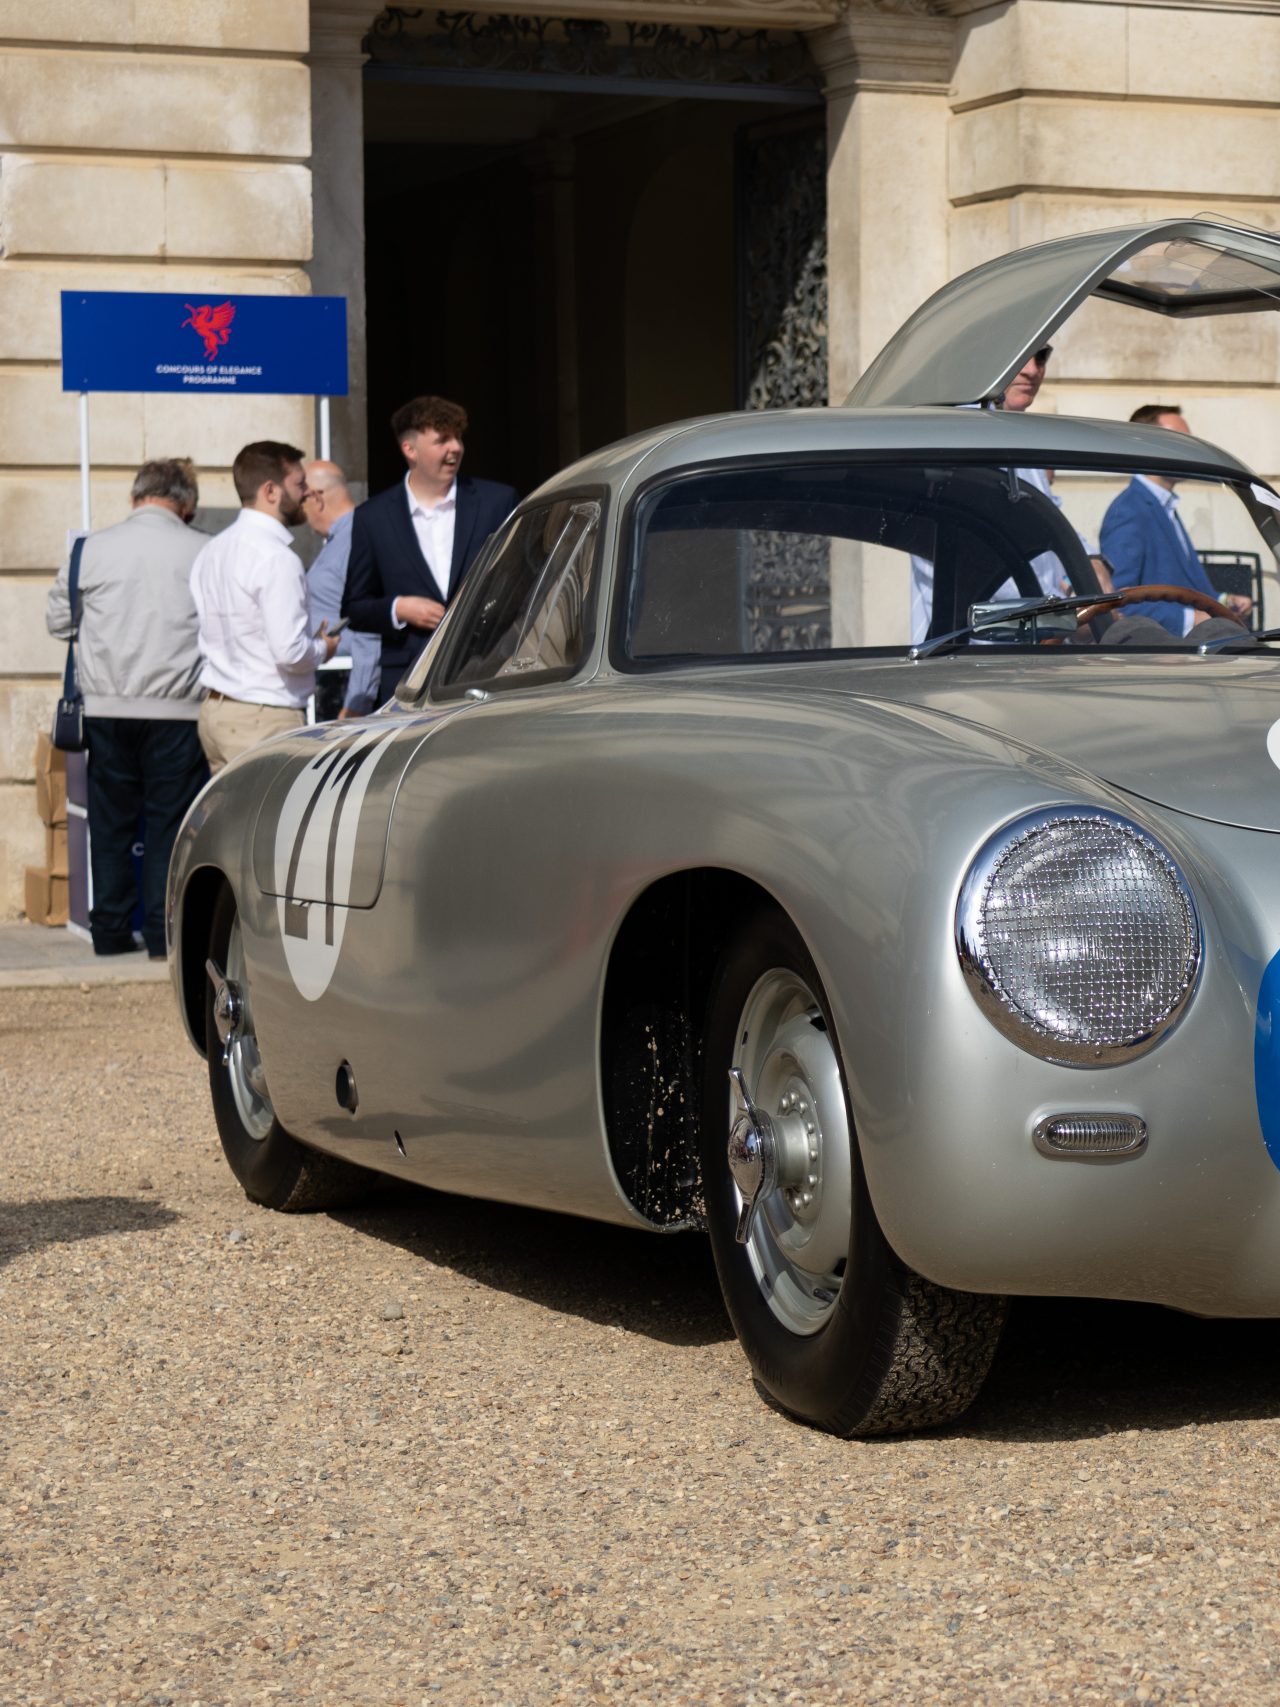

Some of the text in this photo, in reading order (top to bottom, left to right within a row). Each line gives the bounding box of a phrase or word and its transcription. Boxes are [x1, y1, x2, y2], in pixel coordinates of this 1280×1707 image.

[156, 364, 262, 375] CONCOURS OF ELEGANCE
[183, 375, 237, 384] PROGRAMME
